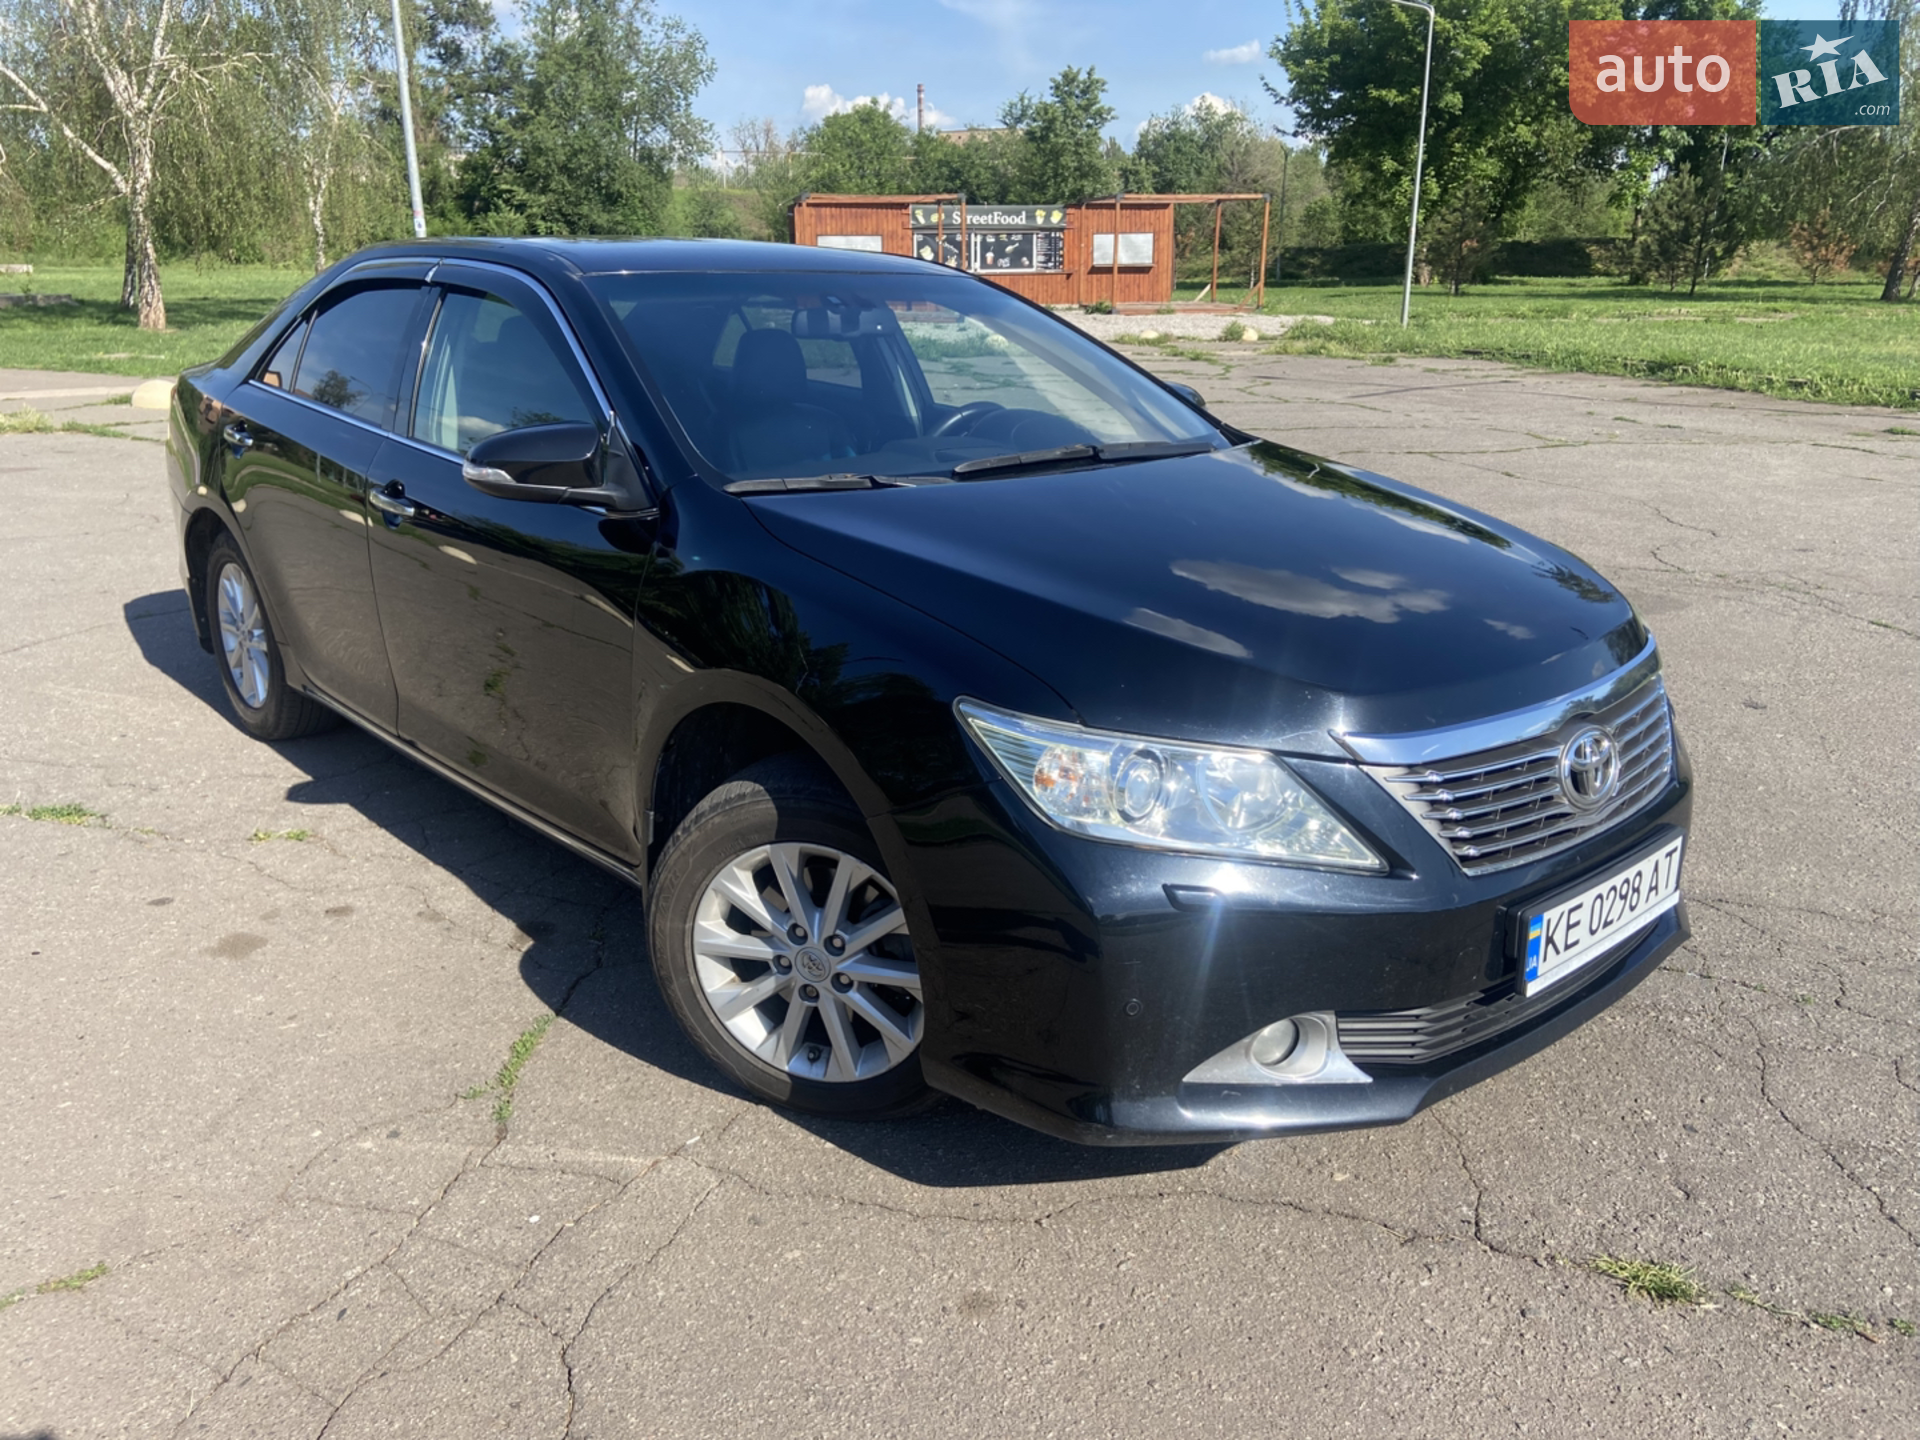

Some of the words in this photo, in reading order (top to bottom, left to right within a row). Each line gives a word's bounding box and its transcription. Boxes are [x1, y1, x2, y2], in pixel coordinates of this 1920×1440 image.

[952, 210, 1027, 225] SreetFood
[1542, 902, 1584, 963] KE
[1588, 869, 1643, 937] 0298
[1645, 846, 1679, 904] AT
